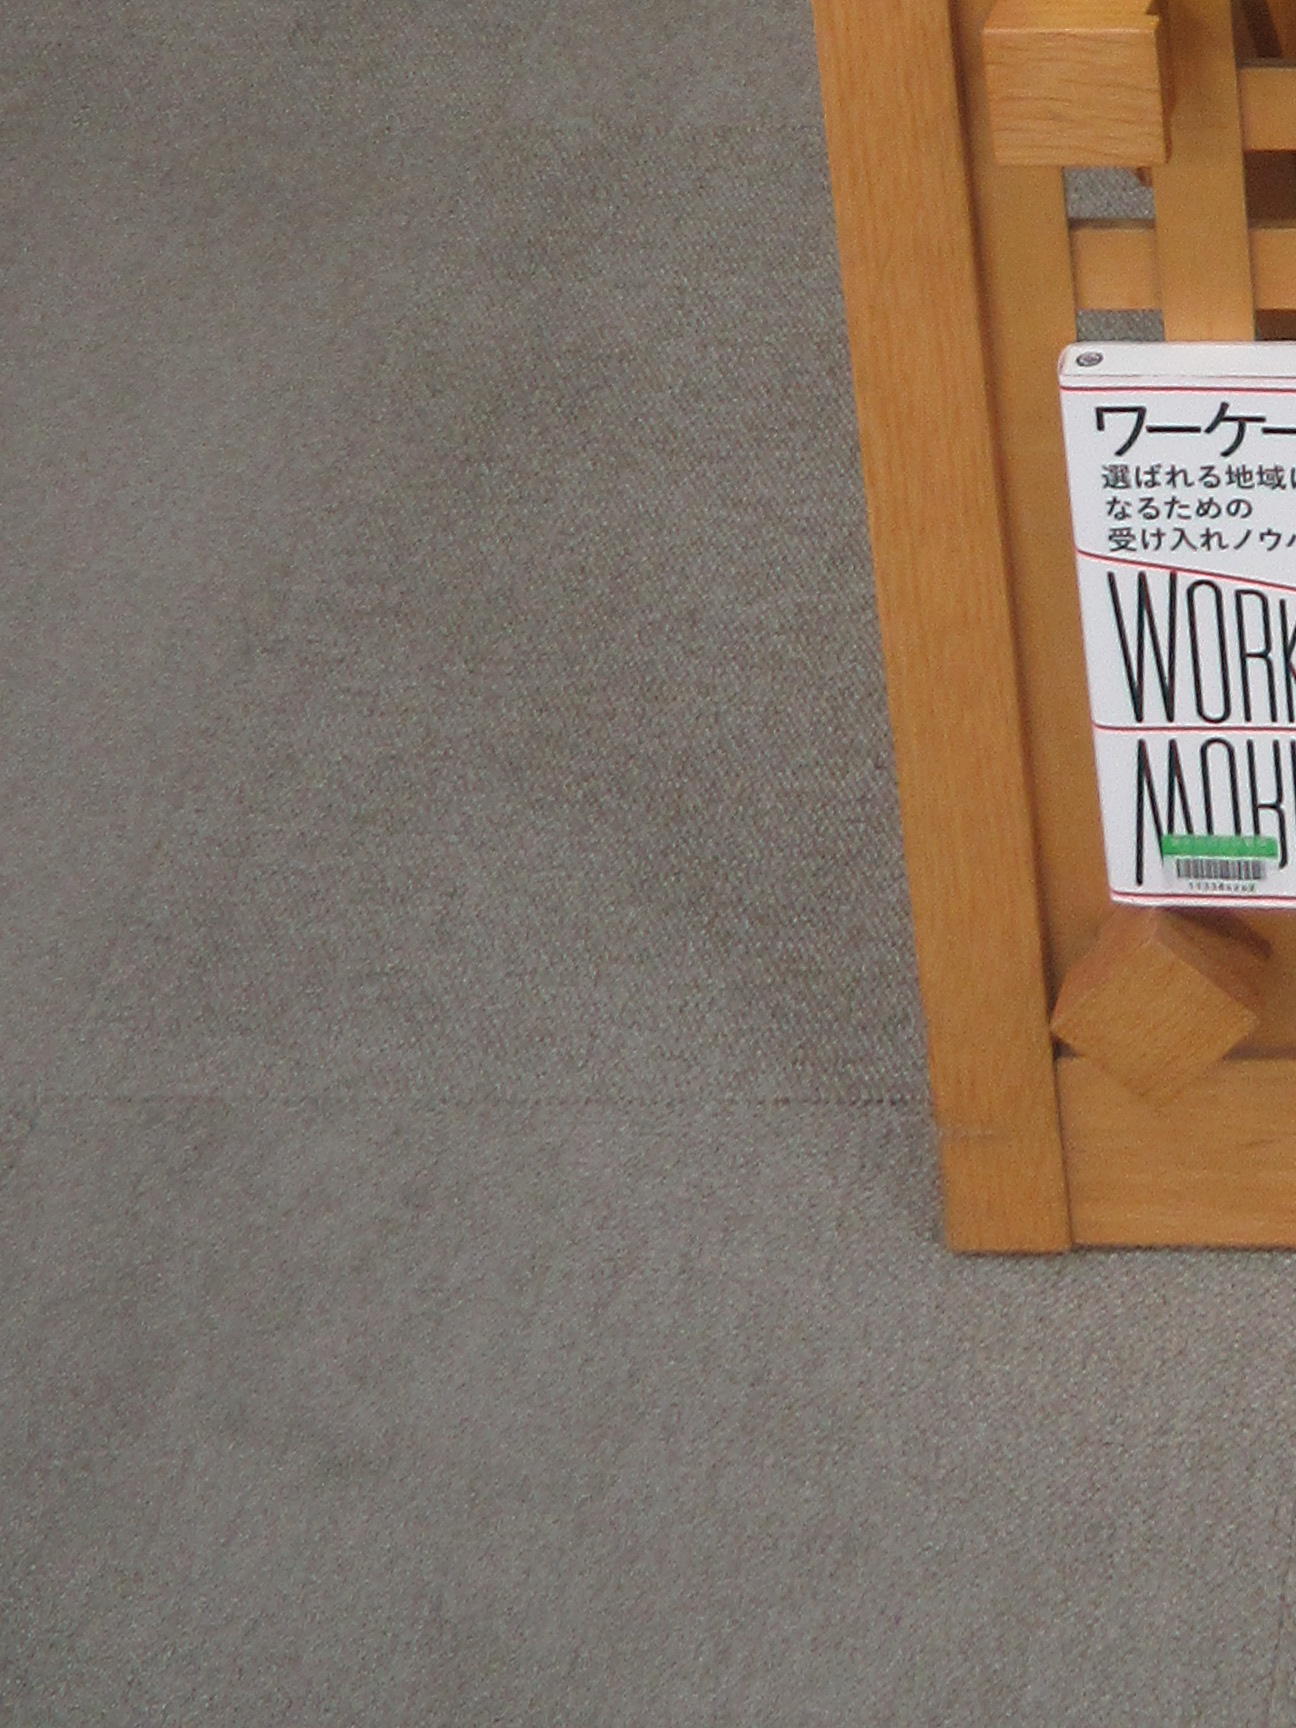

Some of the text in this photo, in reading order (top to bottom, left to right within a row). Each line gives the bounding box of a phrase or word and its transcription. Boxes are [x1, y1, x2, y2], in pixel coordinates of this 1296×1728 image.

[1106, 495, 1253, 521] なるための
